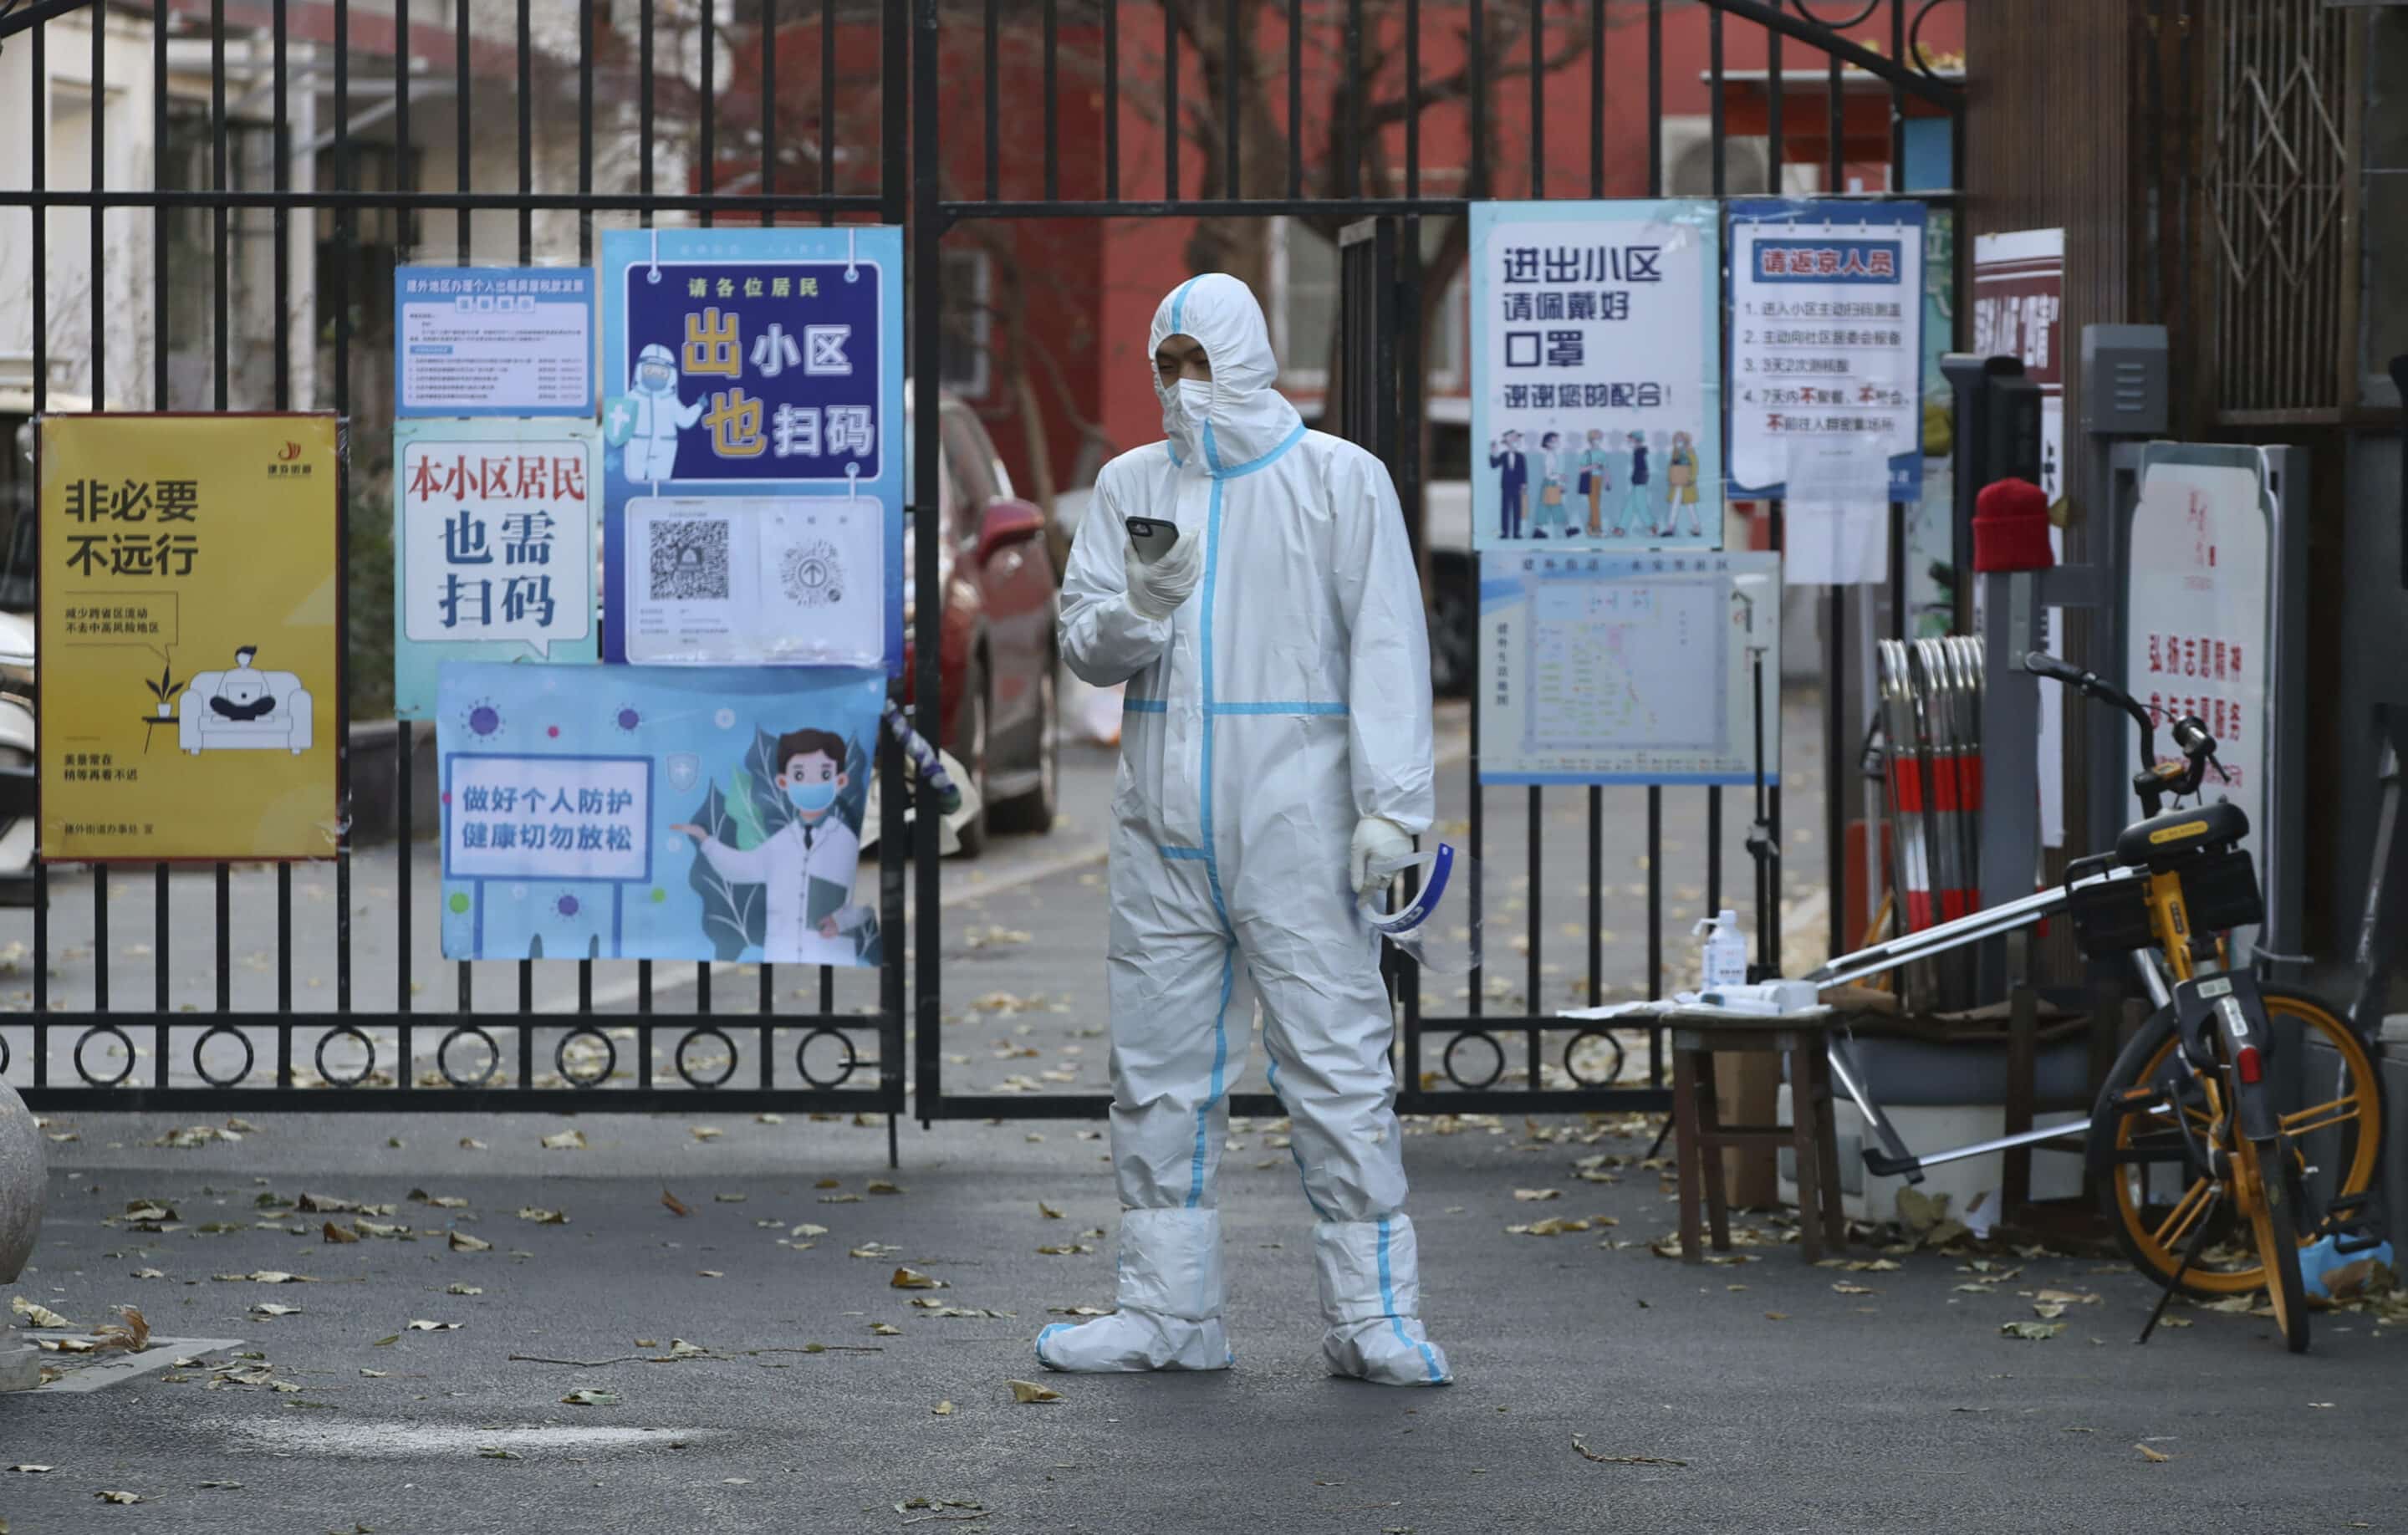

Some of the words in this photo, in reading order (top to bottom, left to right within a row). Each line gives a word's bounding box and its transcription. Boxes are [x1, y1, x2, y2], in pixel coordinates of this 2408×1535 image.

[1503, 246, 1661, 283] 进出小区
[1762, 249, 1895, 276] 请返京人员
[687, 277, 819, 298] 请各位居民
[1503, 291, 1630, 321] 请佩戴好
[681, 306, 853, 380] 出小区
[1505, 329, 1584, 367] 口罩
[701, 387, 875, 457] 也扫码
[408, 455, 585, 502] 本小区居民
[65, 479, 198, 523] 非必要
[66, 533, 198, 577] 不远行
[438, 510, 556, 565] 也需
[65, 607, 148, 620] 减少跨省区流动
[438, 573, 556, 628] 扫码
[65, 620, 160, 634] 不去中高风险地区
[462, 784, 633, 815] 做好个人防护
[462, 822, 632, 852] 健康切勿放松
